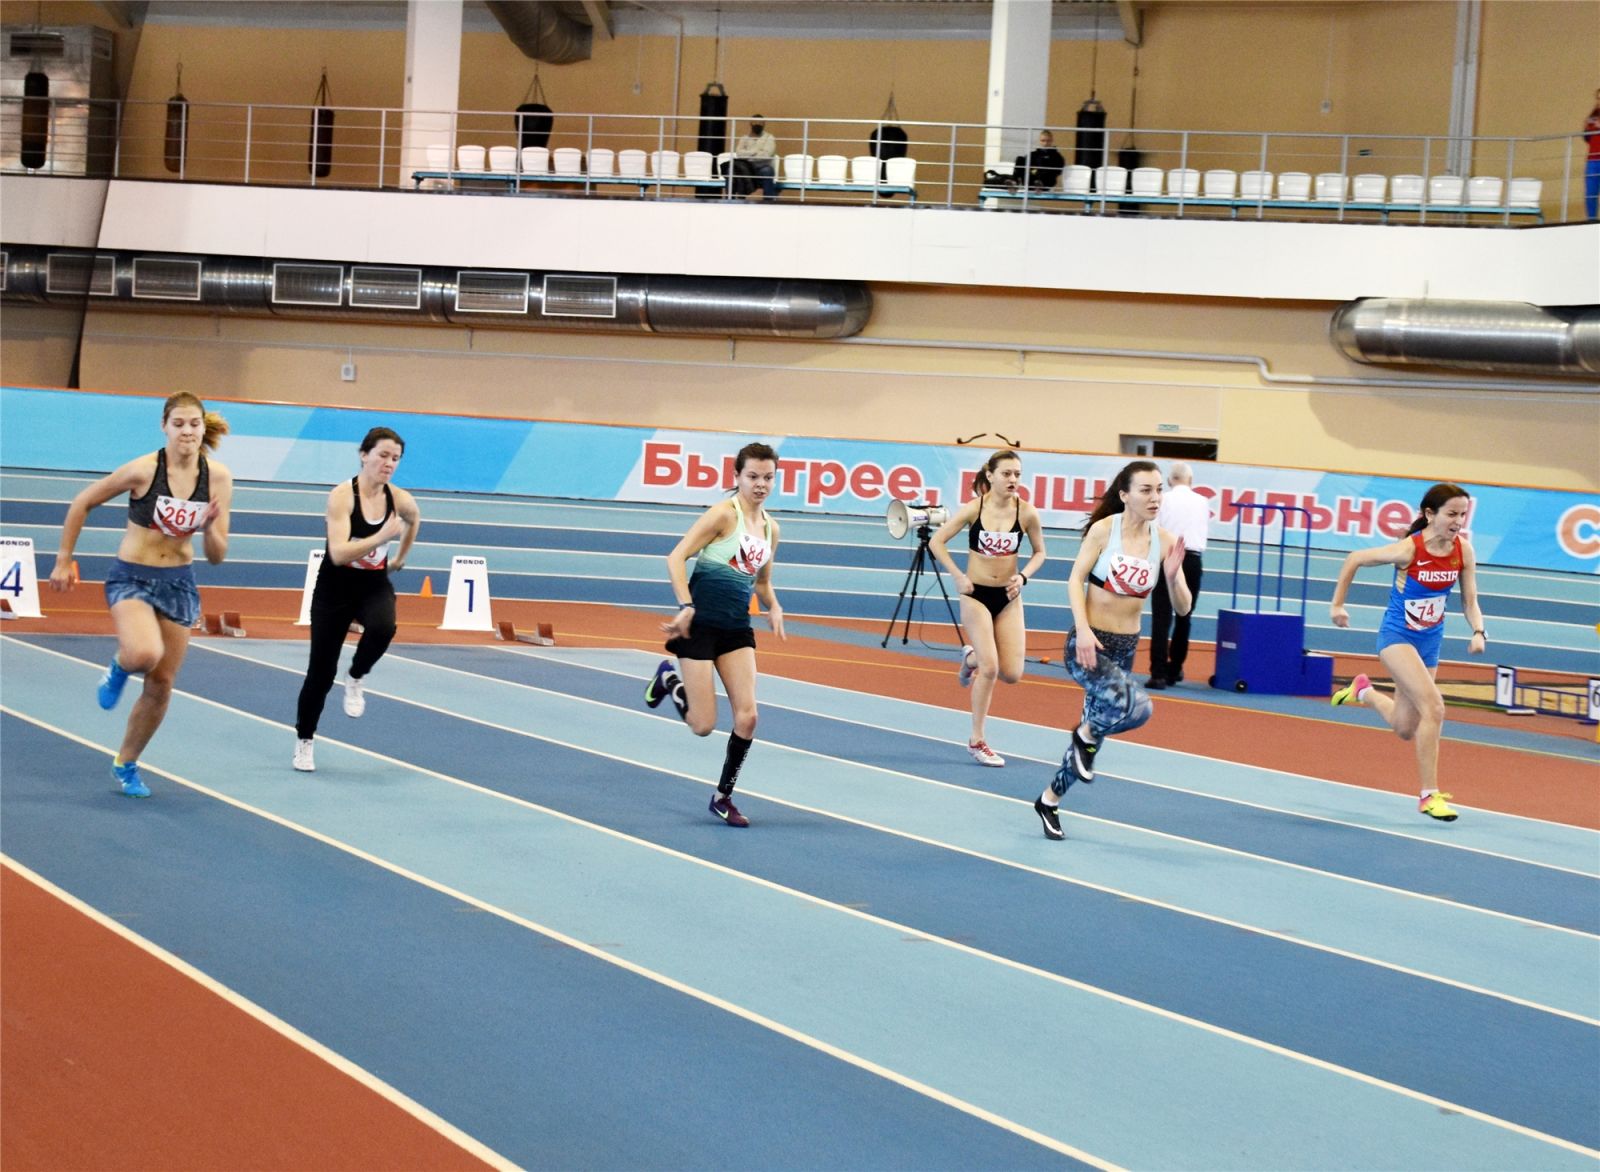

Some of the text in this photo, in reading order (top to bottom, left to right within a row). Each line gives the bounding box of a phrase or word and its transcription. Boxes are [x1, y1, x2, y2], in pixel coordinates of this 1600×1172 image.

[643, 442, 1474, 540] Бытрее, выш ильне
[163, 506, 197, 527] 261
[747, 544, 764, 564] 84
[985, 537, 1012, 551] 242
[0, 561, 23, 597] 4
[1115, 563, 1149, 586] 278
[1417, 570, 1459, 582] RUSSIA
[464, 579, 474, 612] 1
[1417, 603, 1434, 620] 74
